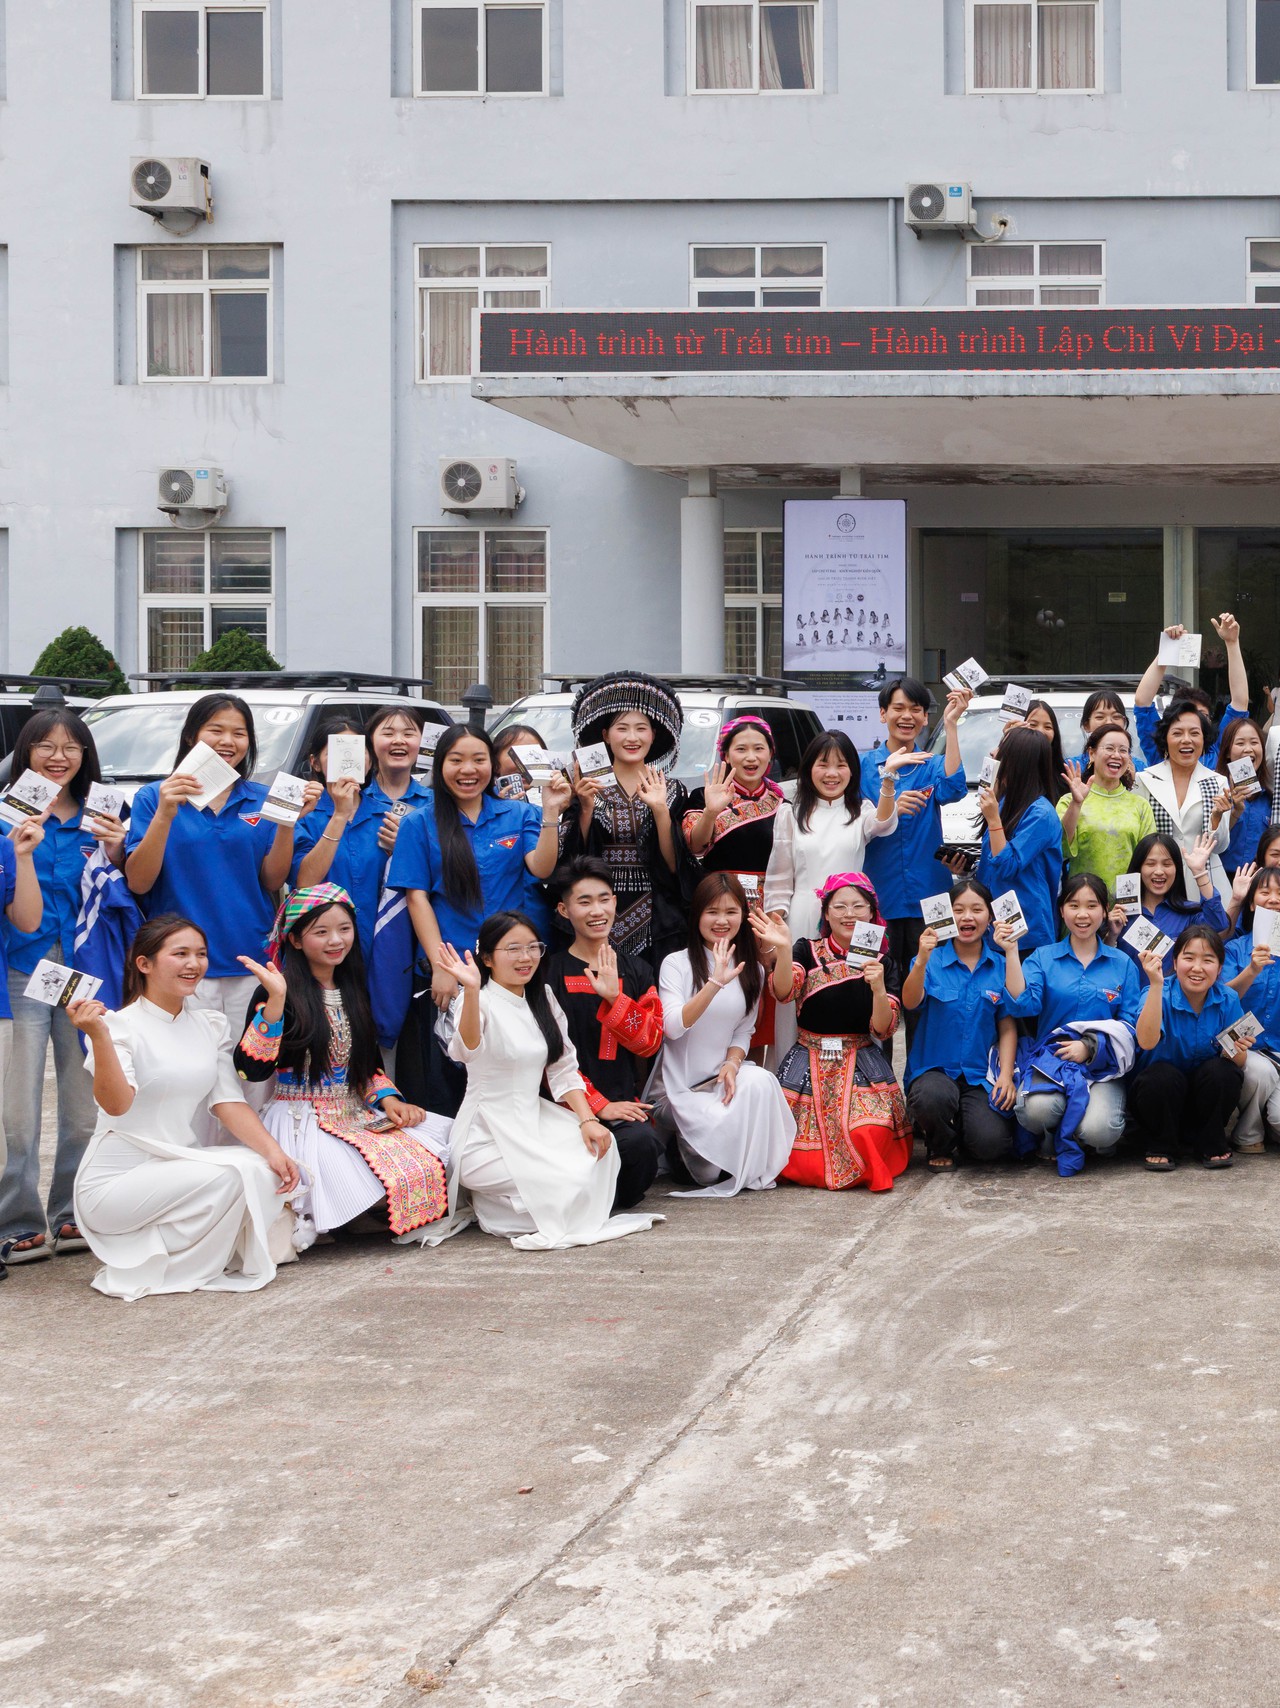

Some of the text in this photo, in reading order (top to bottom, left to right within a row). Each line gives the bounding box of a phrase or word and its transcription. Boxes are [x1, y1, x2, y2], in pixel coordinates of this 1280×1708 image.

[509, 328, 587, 356] Hành
[596, 328, 665, 356] trình
[674, 329, 705, 355] từ
[714, 328, 773, 355] Trái
[784, 328, 831, 354] tim
[874, 327, 948, 354] Hành
[958, 326, 1026, 353] trình
[1037, 326, 1094, 360] Lập
[1103, 325, 1155, 353] Chí
[1167, 324, 1205, 352] Vĩ
[1212, 324, 1264, 355] Đại
[273, 710, 292, 721] 11
[698, 712, 711, 724] 5
